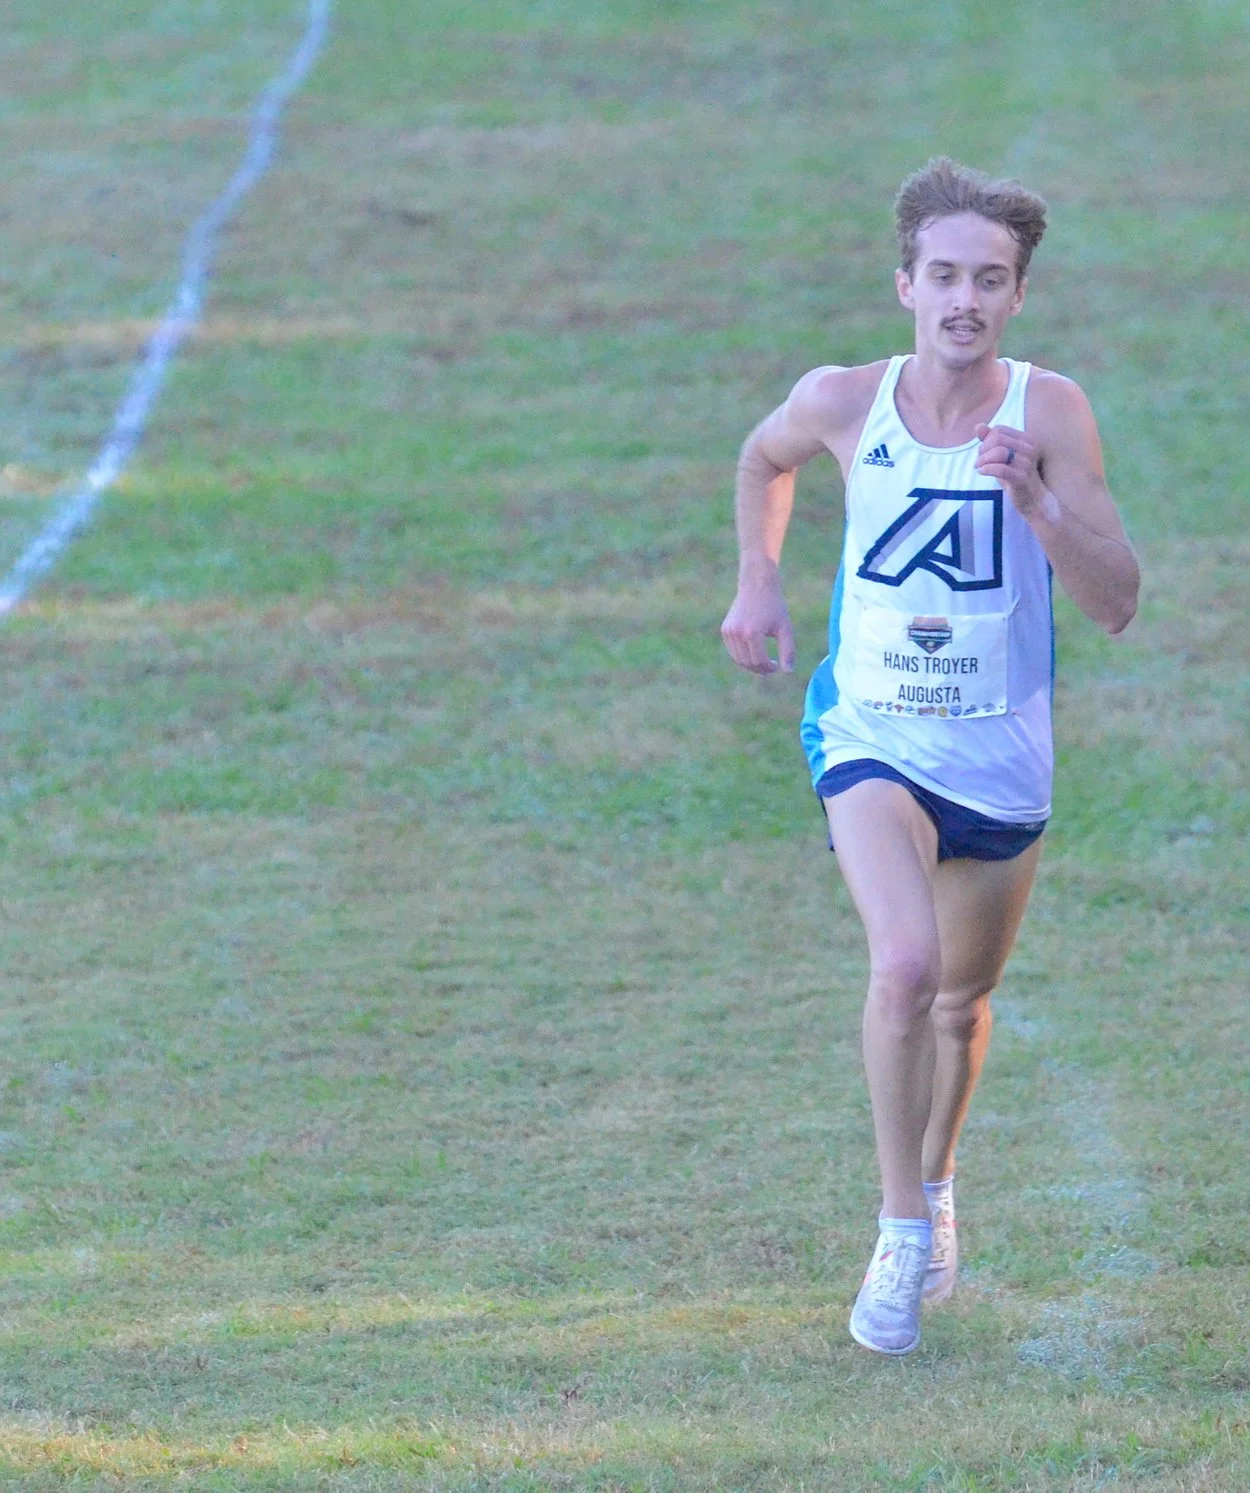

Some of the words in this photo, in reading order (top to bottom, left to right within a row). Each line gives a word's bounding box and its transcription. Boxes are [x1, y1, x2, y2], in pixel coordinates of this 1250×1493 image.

[862, 456, 895, 468] adidas
[883, 651, 919, 673] HANS
[923, 656, 978, 675] TROYER
[898, 683, 961, 704] AUGUSTA
